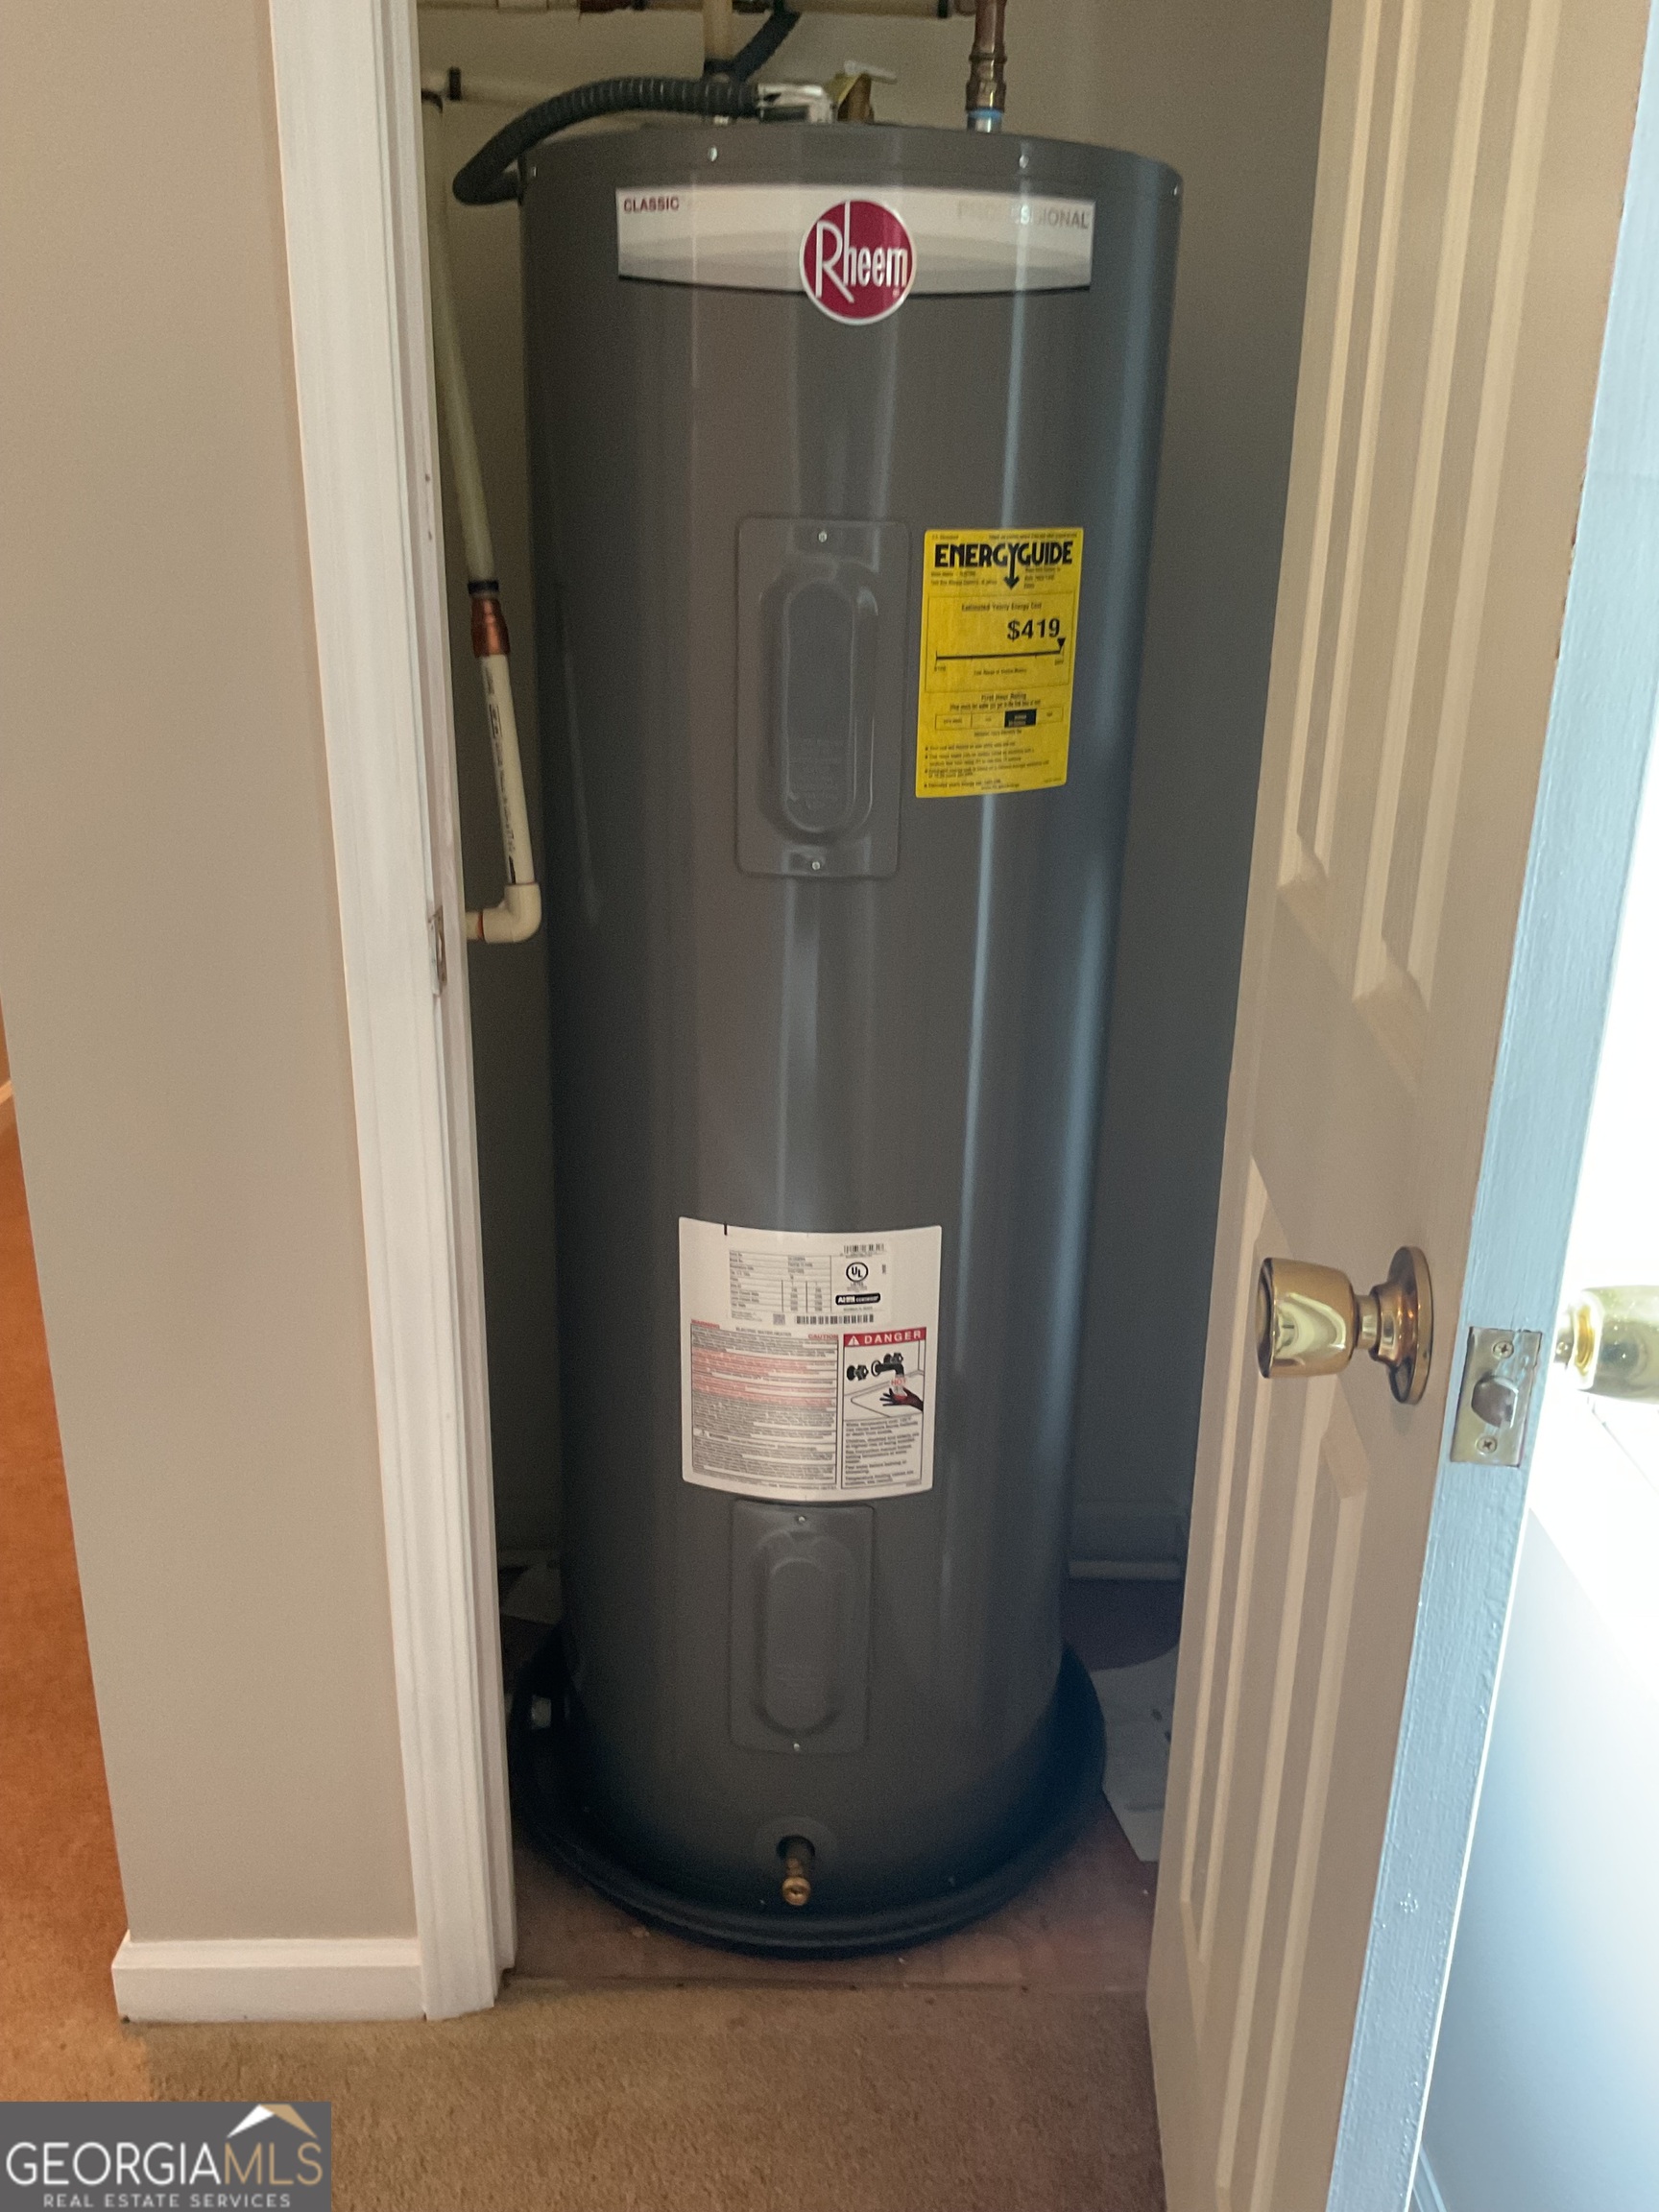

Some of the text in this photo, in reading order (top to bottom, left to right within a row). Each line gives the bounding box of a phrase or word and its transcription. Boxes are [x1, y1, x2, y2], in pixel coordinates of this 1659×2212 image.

[623, 196, 680, 212] CLASSIC
[814, 201, 908, 303] Rheem
[934, 541, 1073, 568] ENERGYGUIDE
[1007, 618, 1060, 641] $419
[864, 1330, 922, 1345] DANGER
